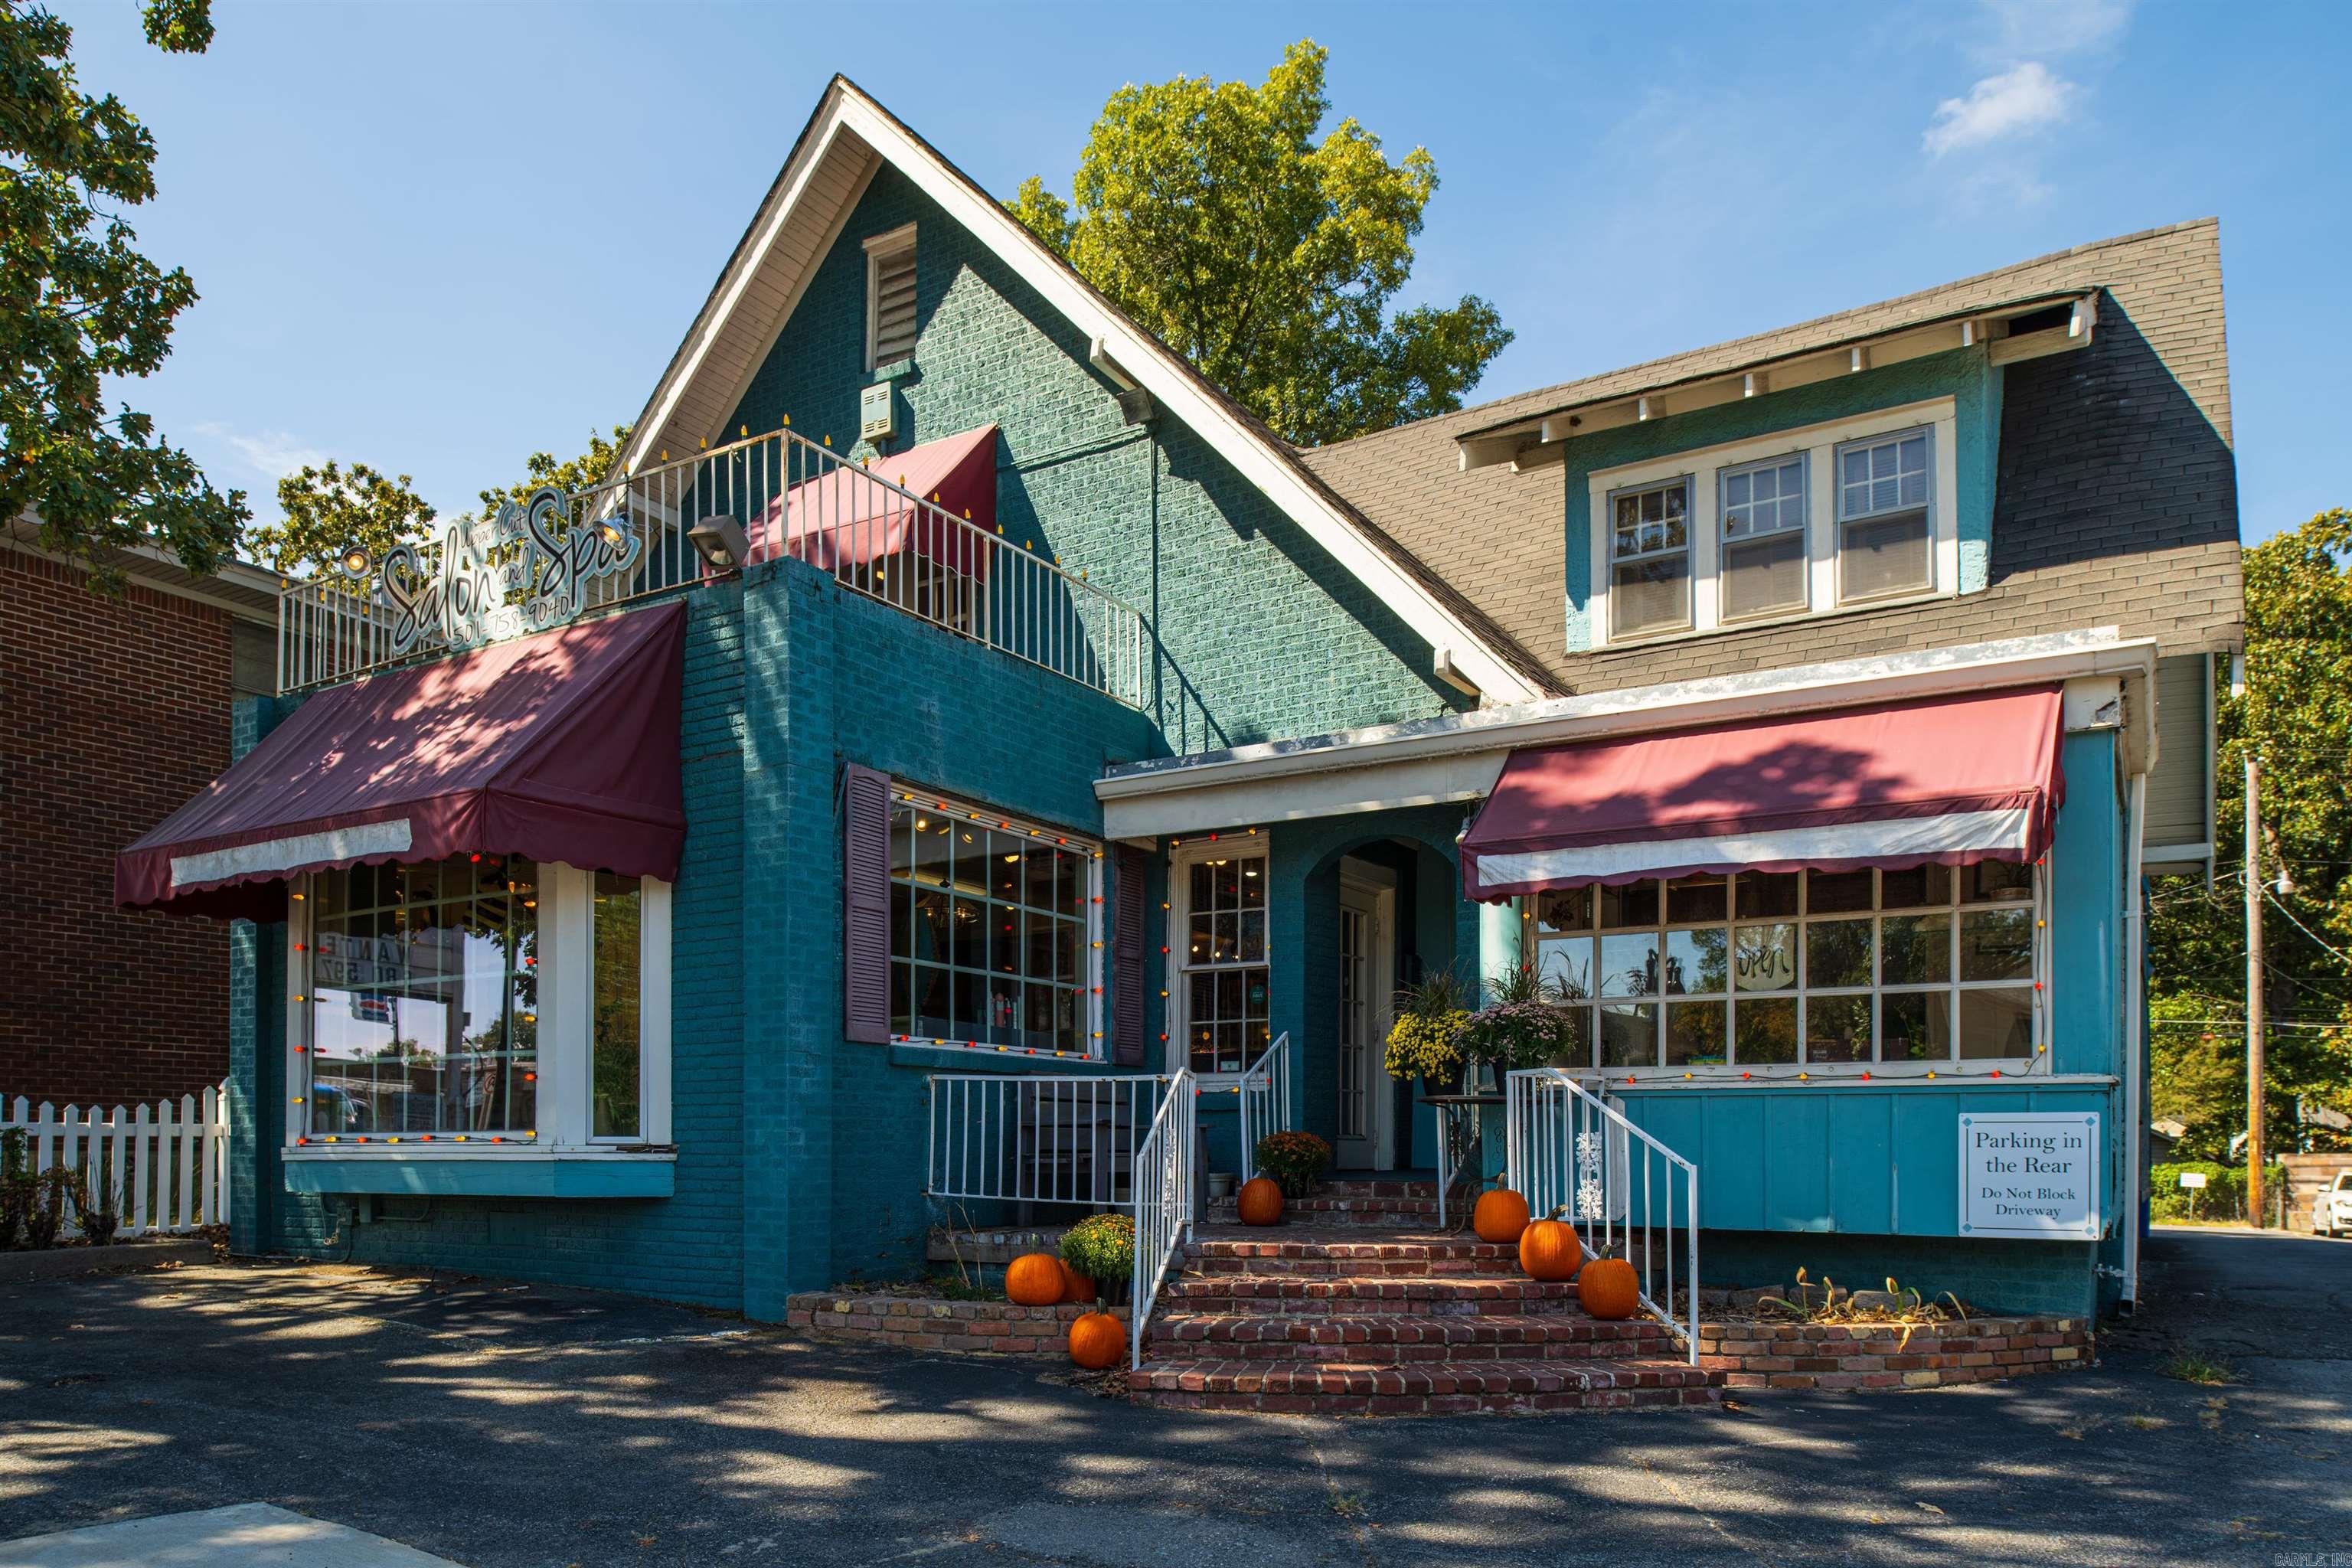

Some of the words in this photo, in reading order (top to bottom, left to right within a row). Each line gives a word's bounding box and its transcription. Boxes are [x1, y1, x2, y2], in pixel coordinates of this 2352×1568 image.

[460, 522, 497, 558] Upper
[499, 505, 527, 536] Cut
[384, 525, 496, 647] Salon
[499, 547, 529, 586] and
[528, 492, 632, 608] Spa
[453, 596, 570, 646] 501-758-9040
[1975, 1132, 2056, 1154] Parking
[2063, 1132, 2082, 1148] in
[1986, 1157, 2017, 1173] the
[2024, 1157, 2073, 1174] Rear
[1981, 1187, 2002, 1199] Do
[2006, 1187, 2033, 1200] Not
[2037, 1187, 2076, 1200] Block
[1995, 1204, 2062, 1220] Driveway
